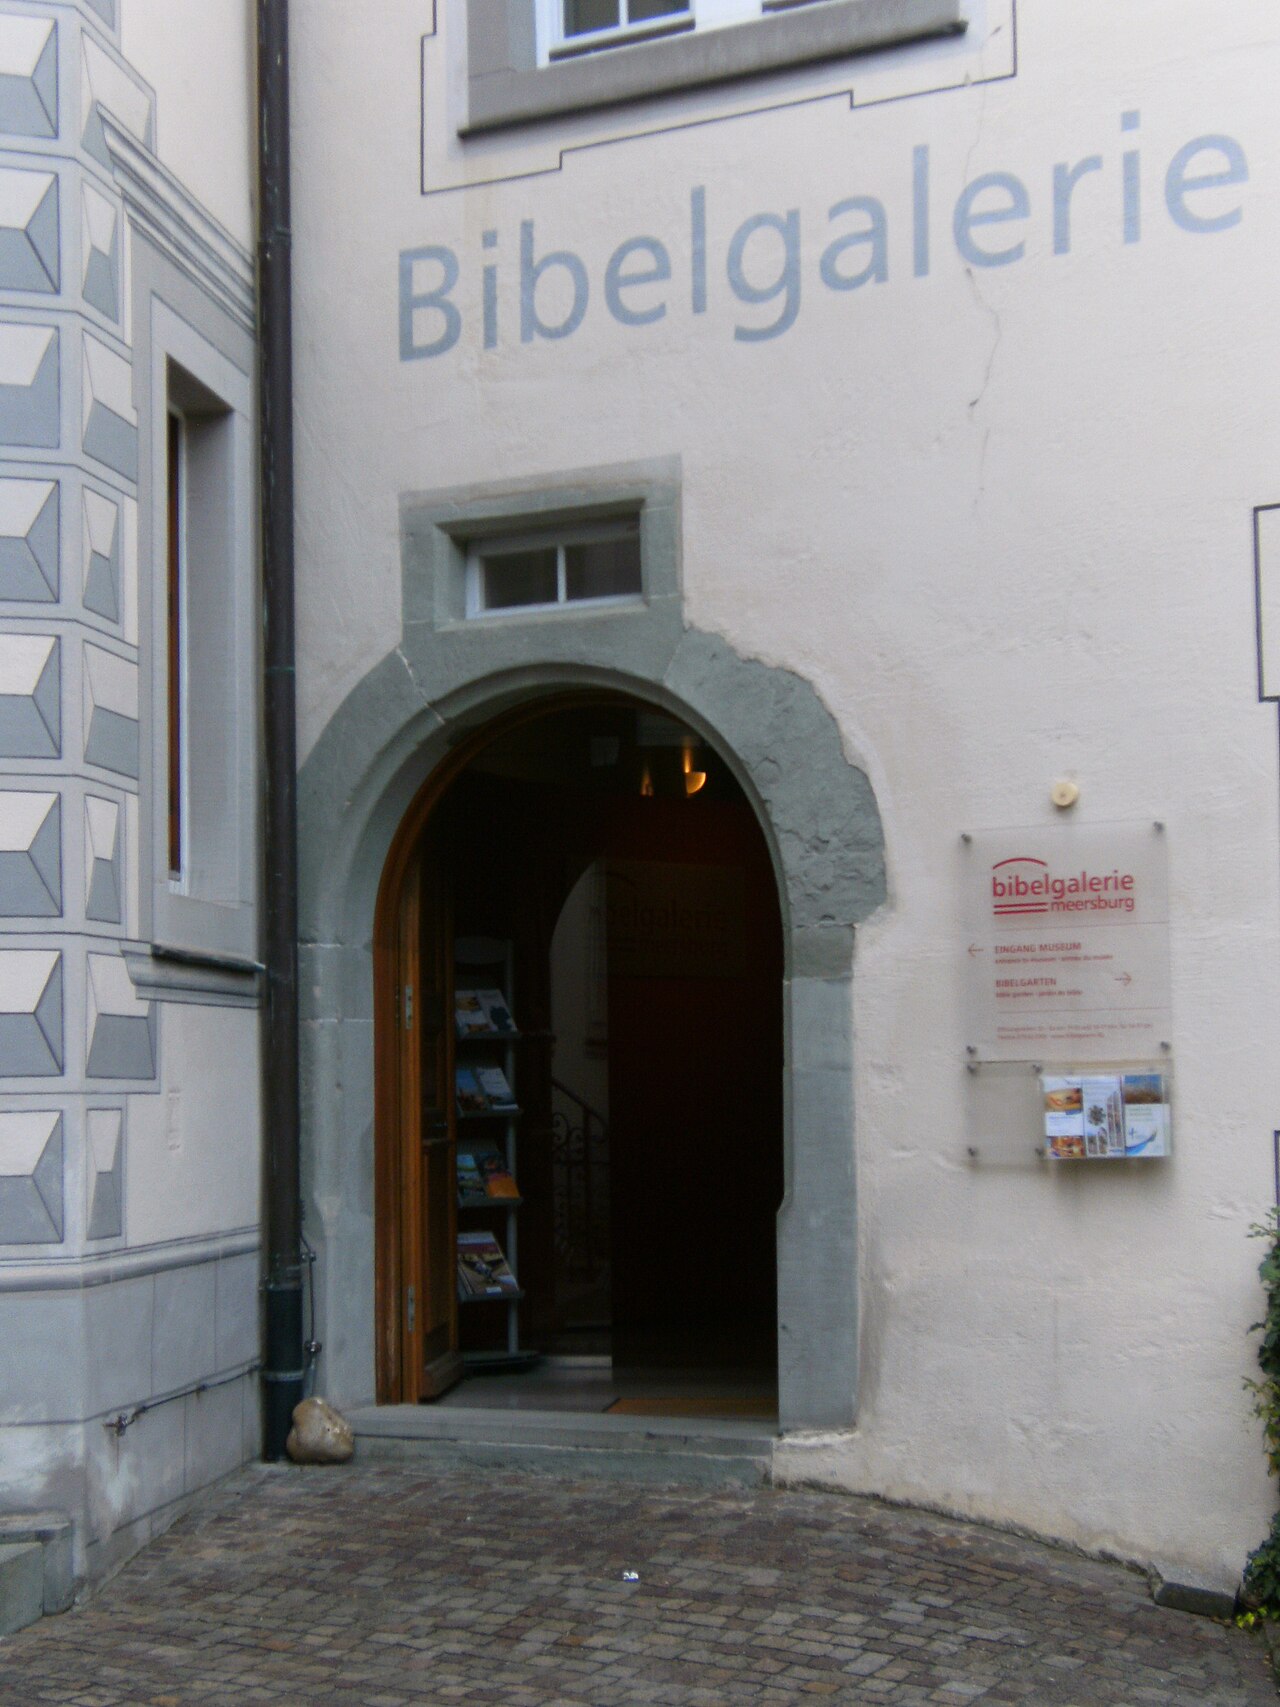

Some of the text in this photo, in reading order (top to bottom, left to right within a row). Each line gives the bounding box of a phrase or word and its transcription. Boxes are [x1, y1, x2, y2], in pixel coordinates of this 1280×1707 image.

[399, 109, 1250, 362] Bibelgalerie
[992, 870, 1135, 900] bibelgalerie
[1050, 895, 1135, 912] meersburg
[995, 943, 1081, 954] EINGANG MUSEUM
[995, 978, 1057, 988] BIBELGARTEN
